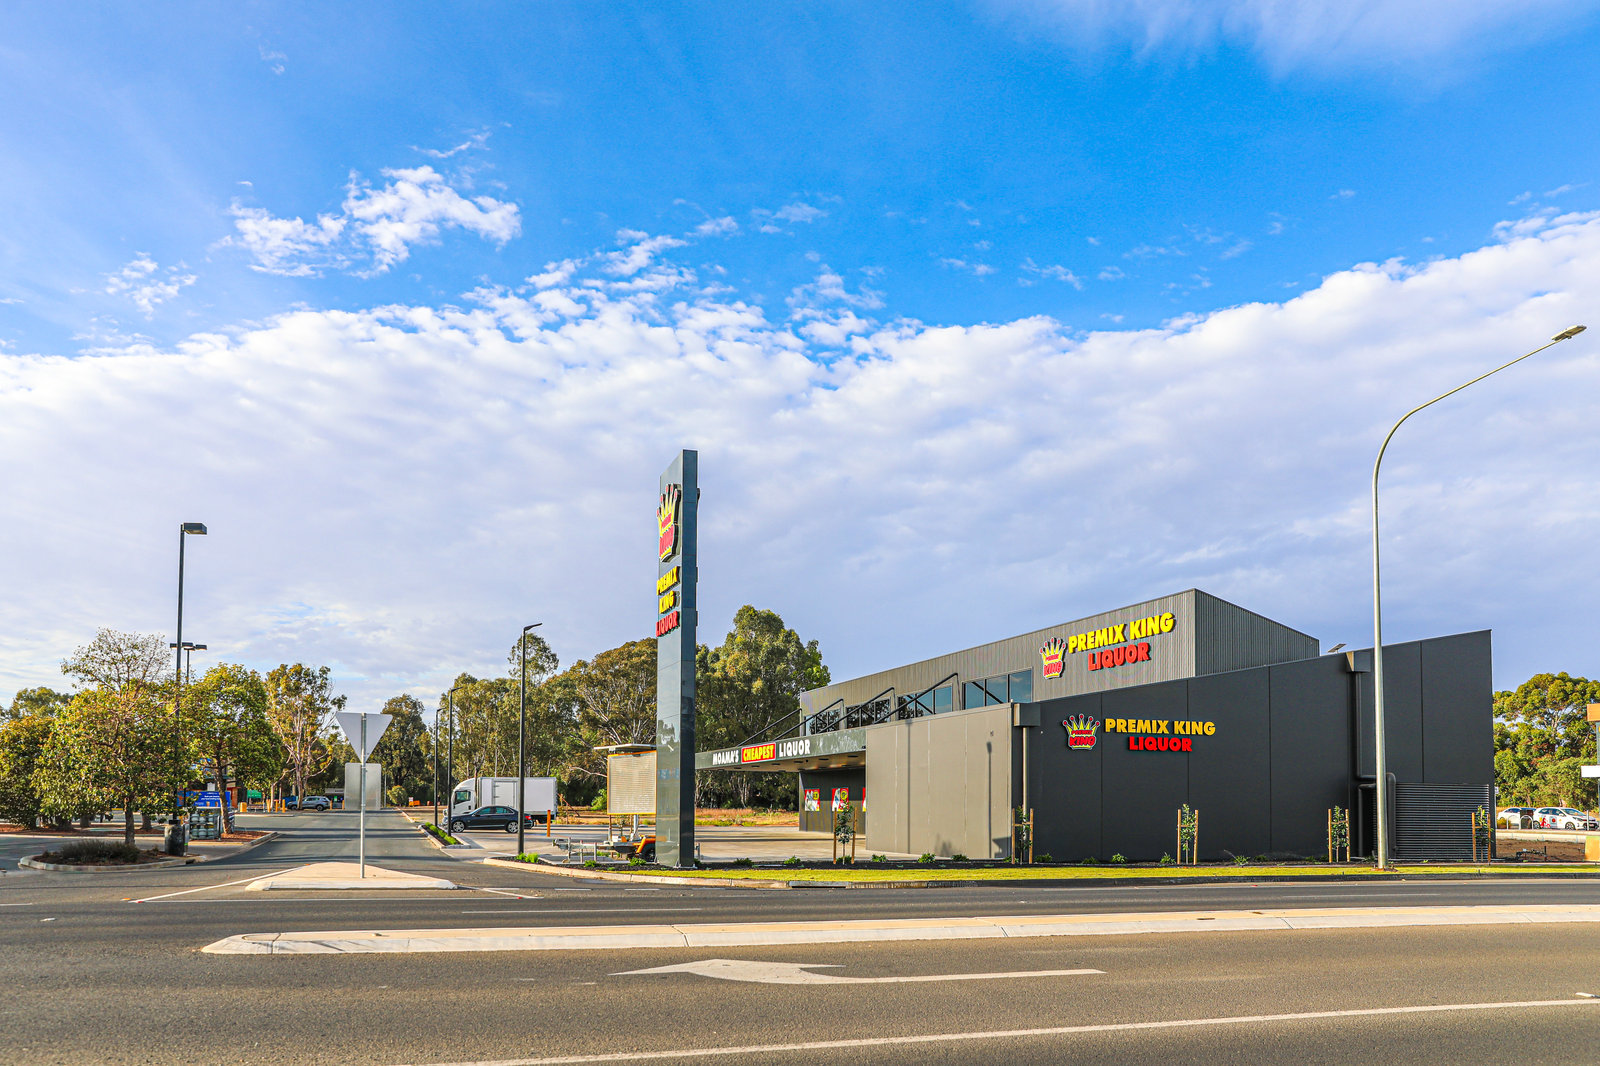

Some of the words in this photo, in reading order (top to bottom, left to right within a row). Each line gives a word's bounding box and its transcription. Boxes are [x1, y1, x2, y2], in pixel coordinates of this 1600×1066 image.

[656, 565, 678, 596] PREMIX
[659, 590, 675, 614] KING
[656, 610, 678, 637] LIQUOR
[1068, 623, 1126, 654] PREMIX
[1129, 612, 1175, 640] KING
[1087, 642, 1150, 671] LIQUOR
[1105, 718, 1169, 734] PREMIX
[1173, 720, 1216, 736] KING
[743, 745, 774, 761] CHEAPEST
[779, 739, 810, 757] LIQUOR
[1069, 736, 1096, 746] KING
[1128, 736, 1193, 752] LIQUOR
